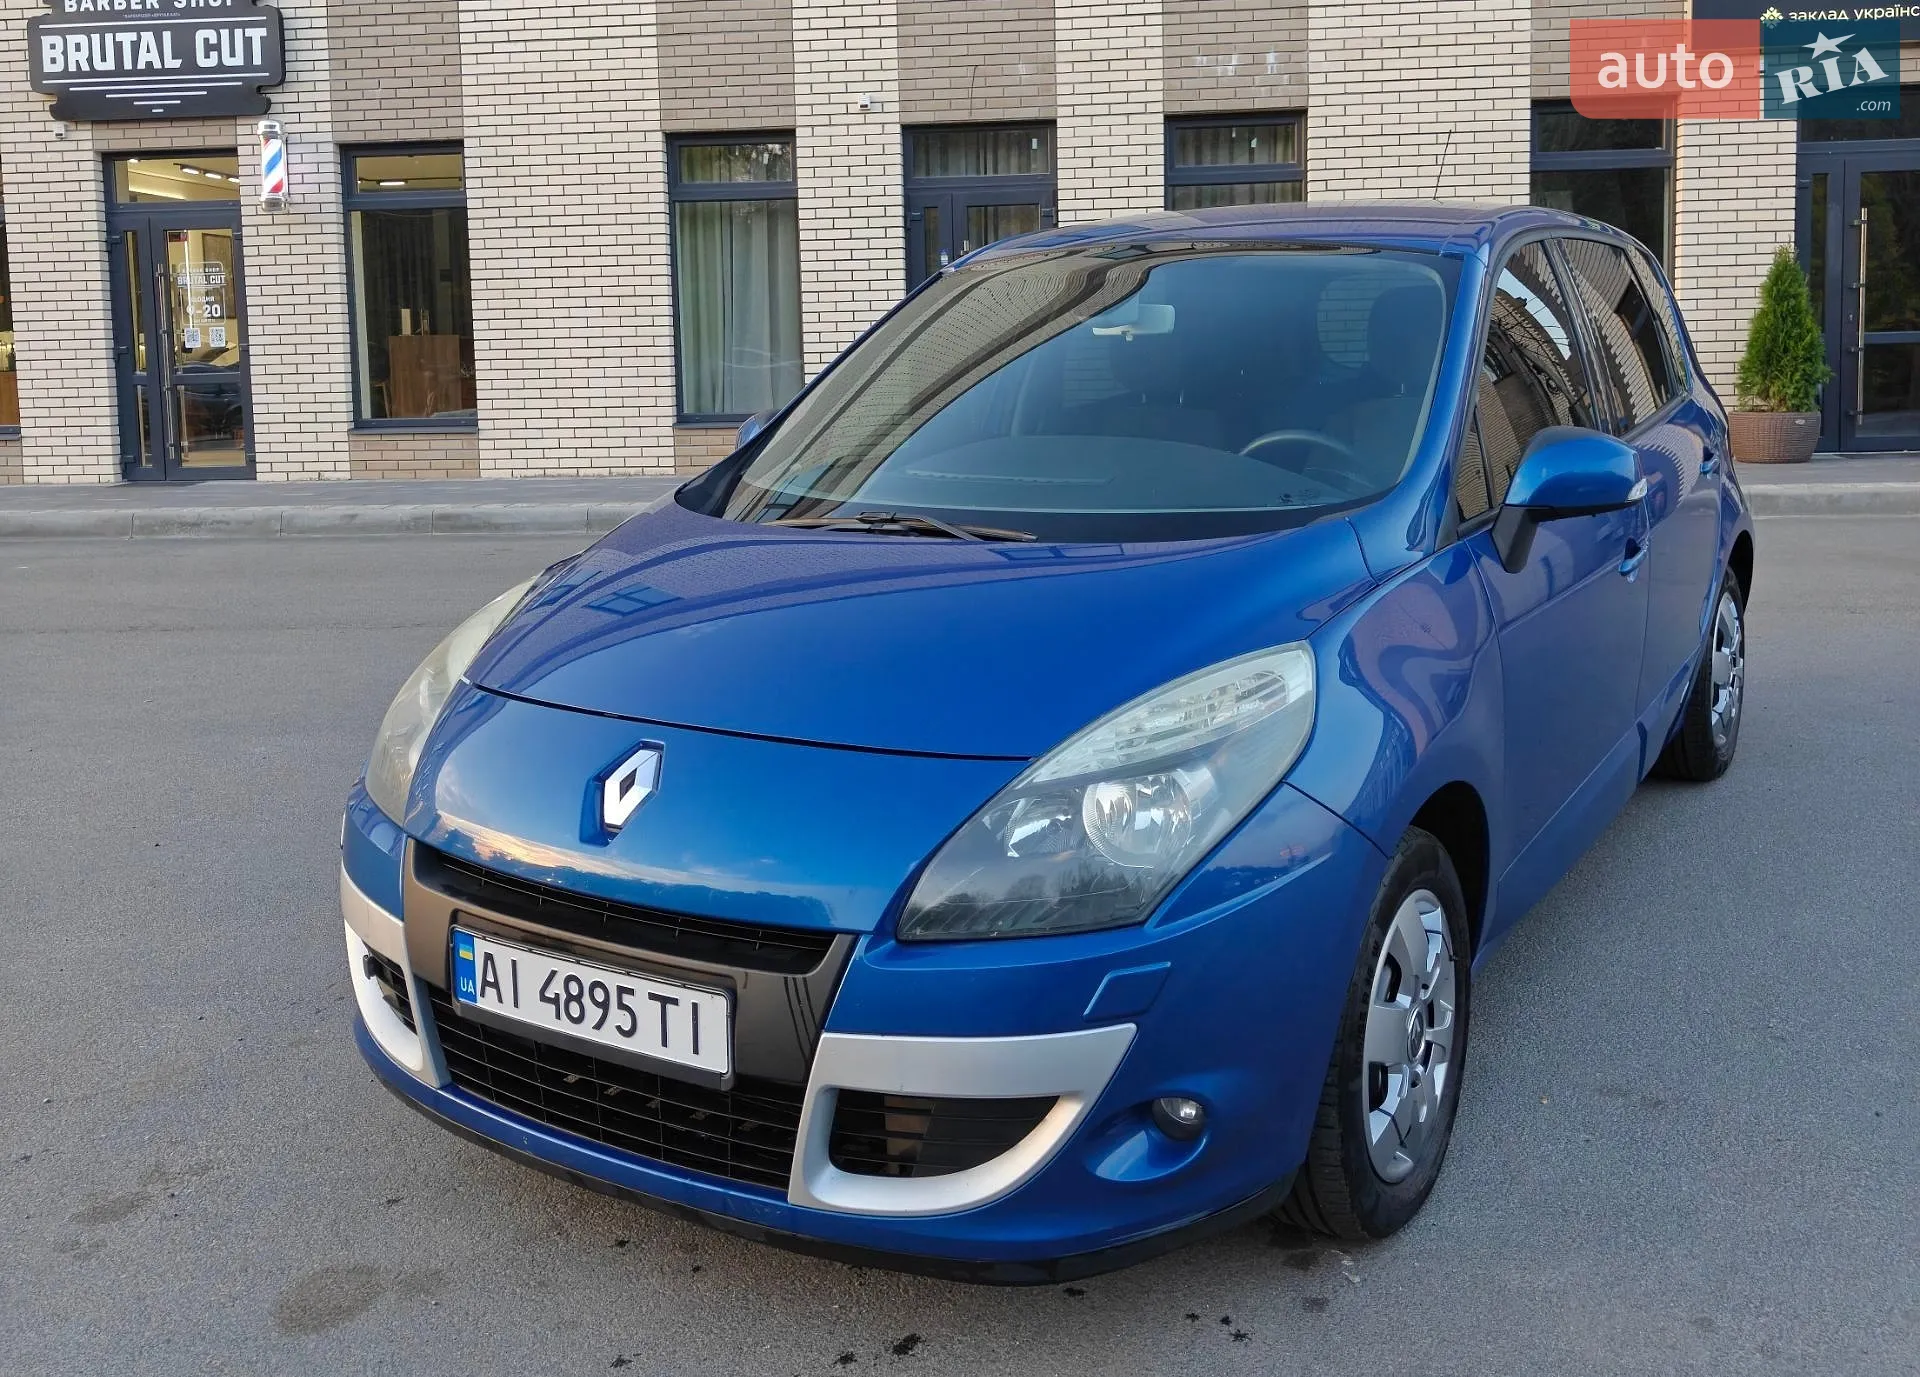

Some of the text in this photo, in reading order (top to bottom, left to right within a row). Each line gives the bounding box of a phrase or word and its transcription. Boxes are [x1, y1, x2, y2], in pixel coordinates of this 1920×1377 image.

[1788, 9, 1849, 22] заклад
[41, 28, 267, 73] BRUTAL CUT
[210, 275, 226, 284] CUT
[459, 978, 476, 994] UA
[479, 951, 700, 1056] AI 4895 TI
